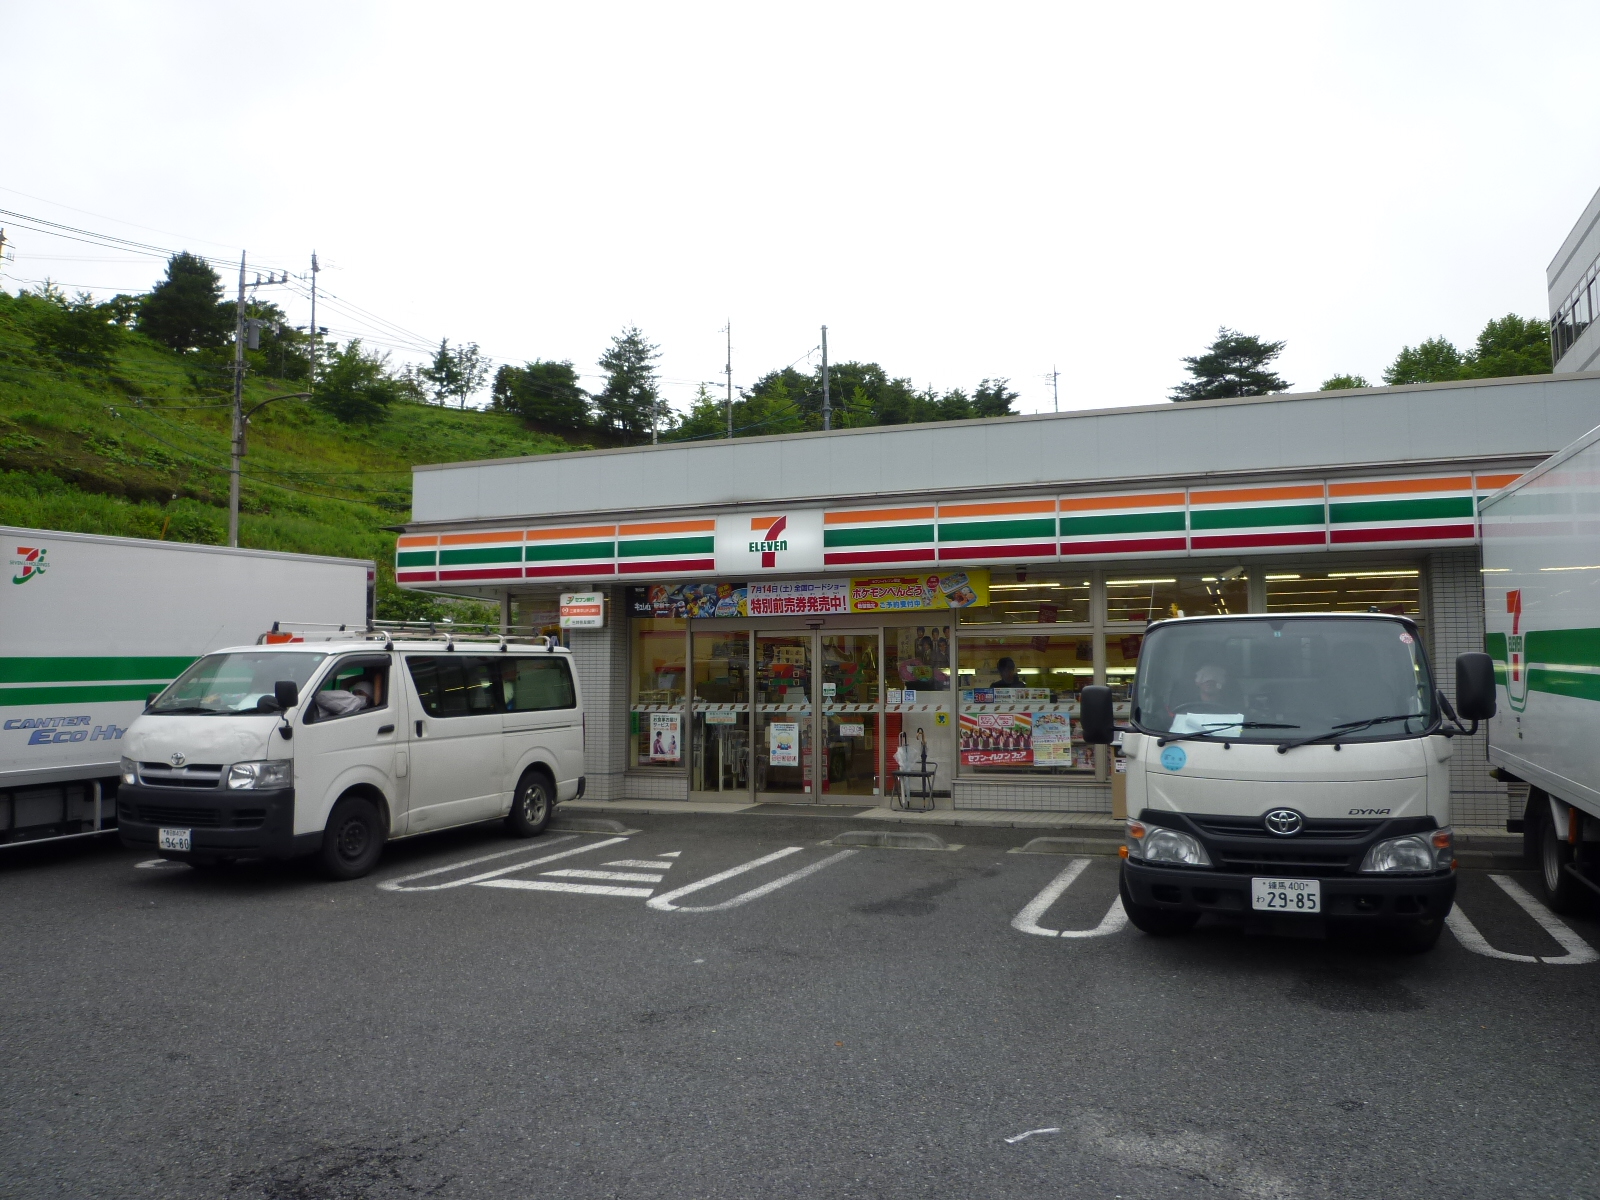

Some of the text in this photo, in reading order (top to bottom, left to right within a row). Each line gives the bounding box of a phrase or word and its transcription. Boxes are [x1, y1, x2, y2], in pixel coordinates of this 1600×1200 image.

[751, 595, 847, 614] 特別前売券発売中!
[3, 715, 91, 730] CANTER
[165, 837, 189, 849] 96-80
[1288, 882, 1304, 890] 400
[1267, 891, 1316, 909] 29-85
